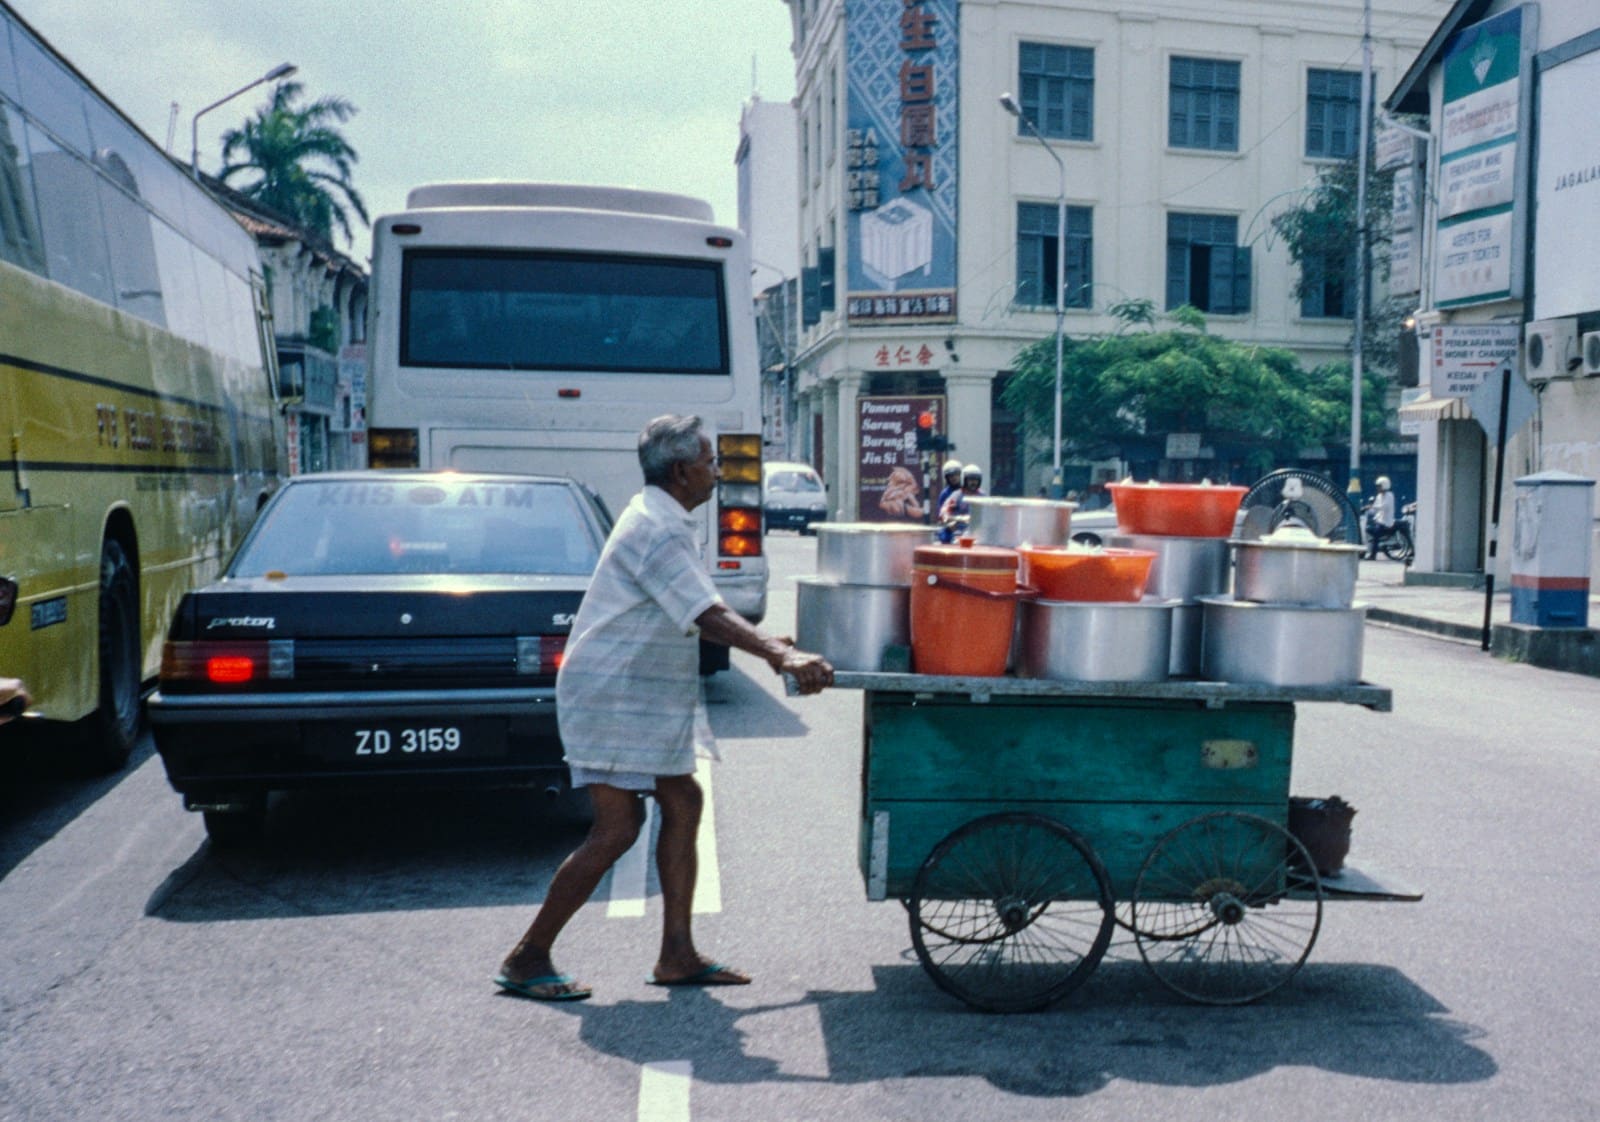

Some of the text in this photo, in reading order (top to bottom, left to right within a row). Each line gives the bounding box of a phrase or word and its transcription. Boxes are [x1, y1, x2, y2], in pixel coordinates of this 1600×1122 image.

[1444, 350, 1473, 358] MONEY
[1447, 371, 1477, 380] KEDAI
[861, 401, 910, 414] Pameran
[861, 435, 904, 450] Burung
[861, 451, 897, 465] Jin Si
[319, 485, 533, 508] KHS ATM
[206, 616, 276, 630] proton
[552, 613, 577, 626] SA
[355, 727, 461, 755] ZD 3159
